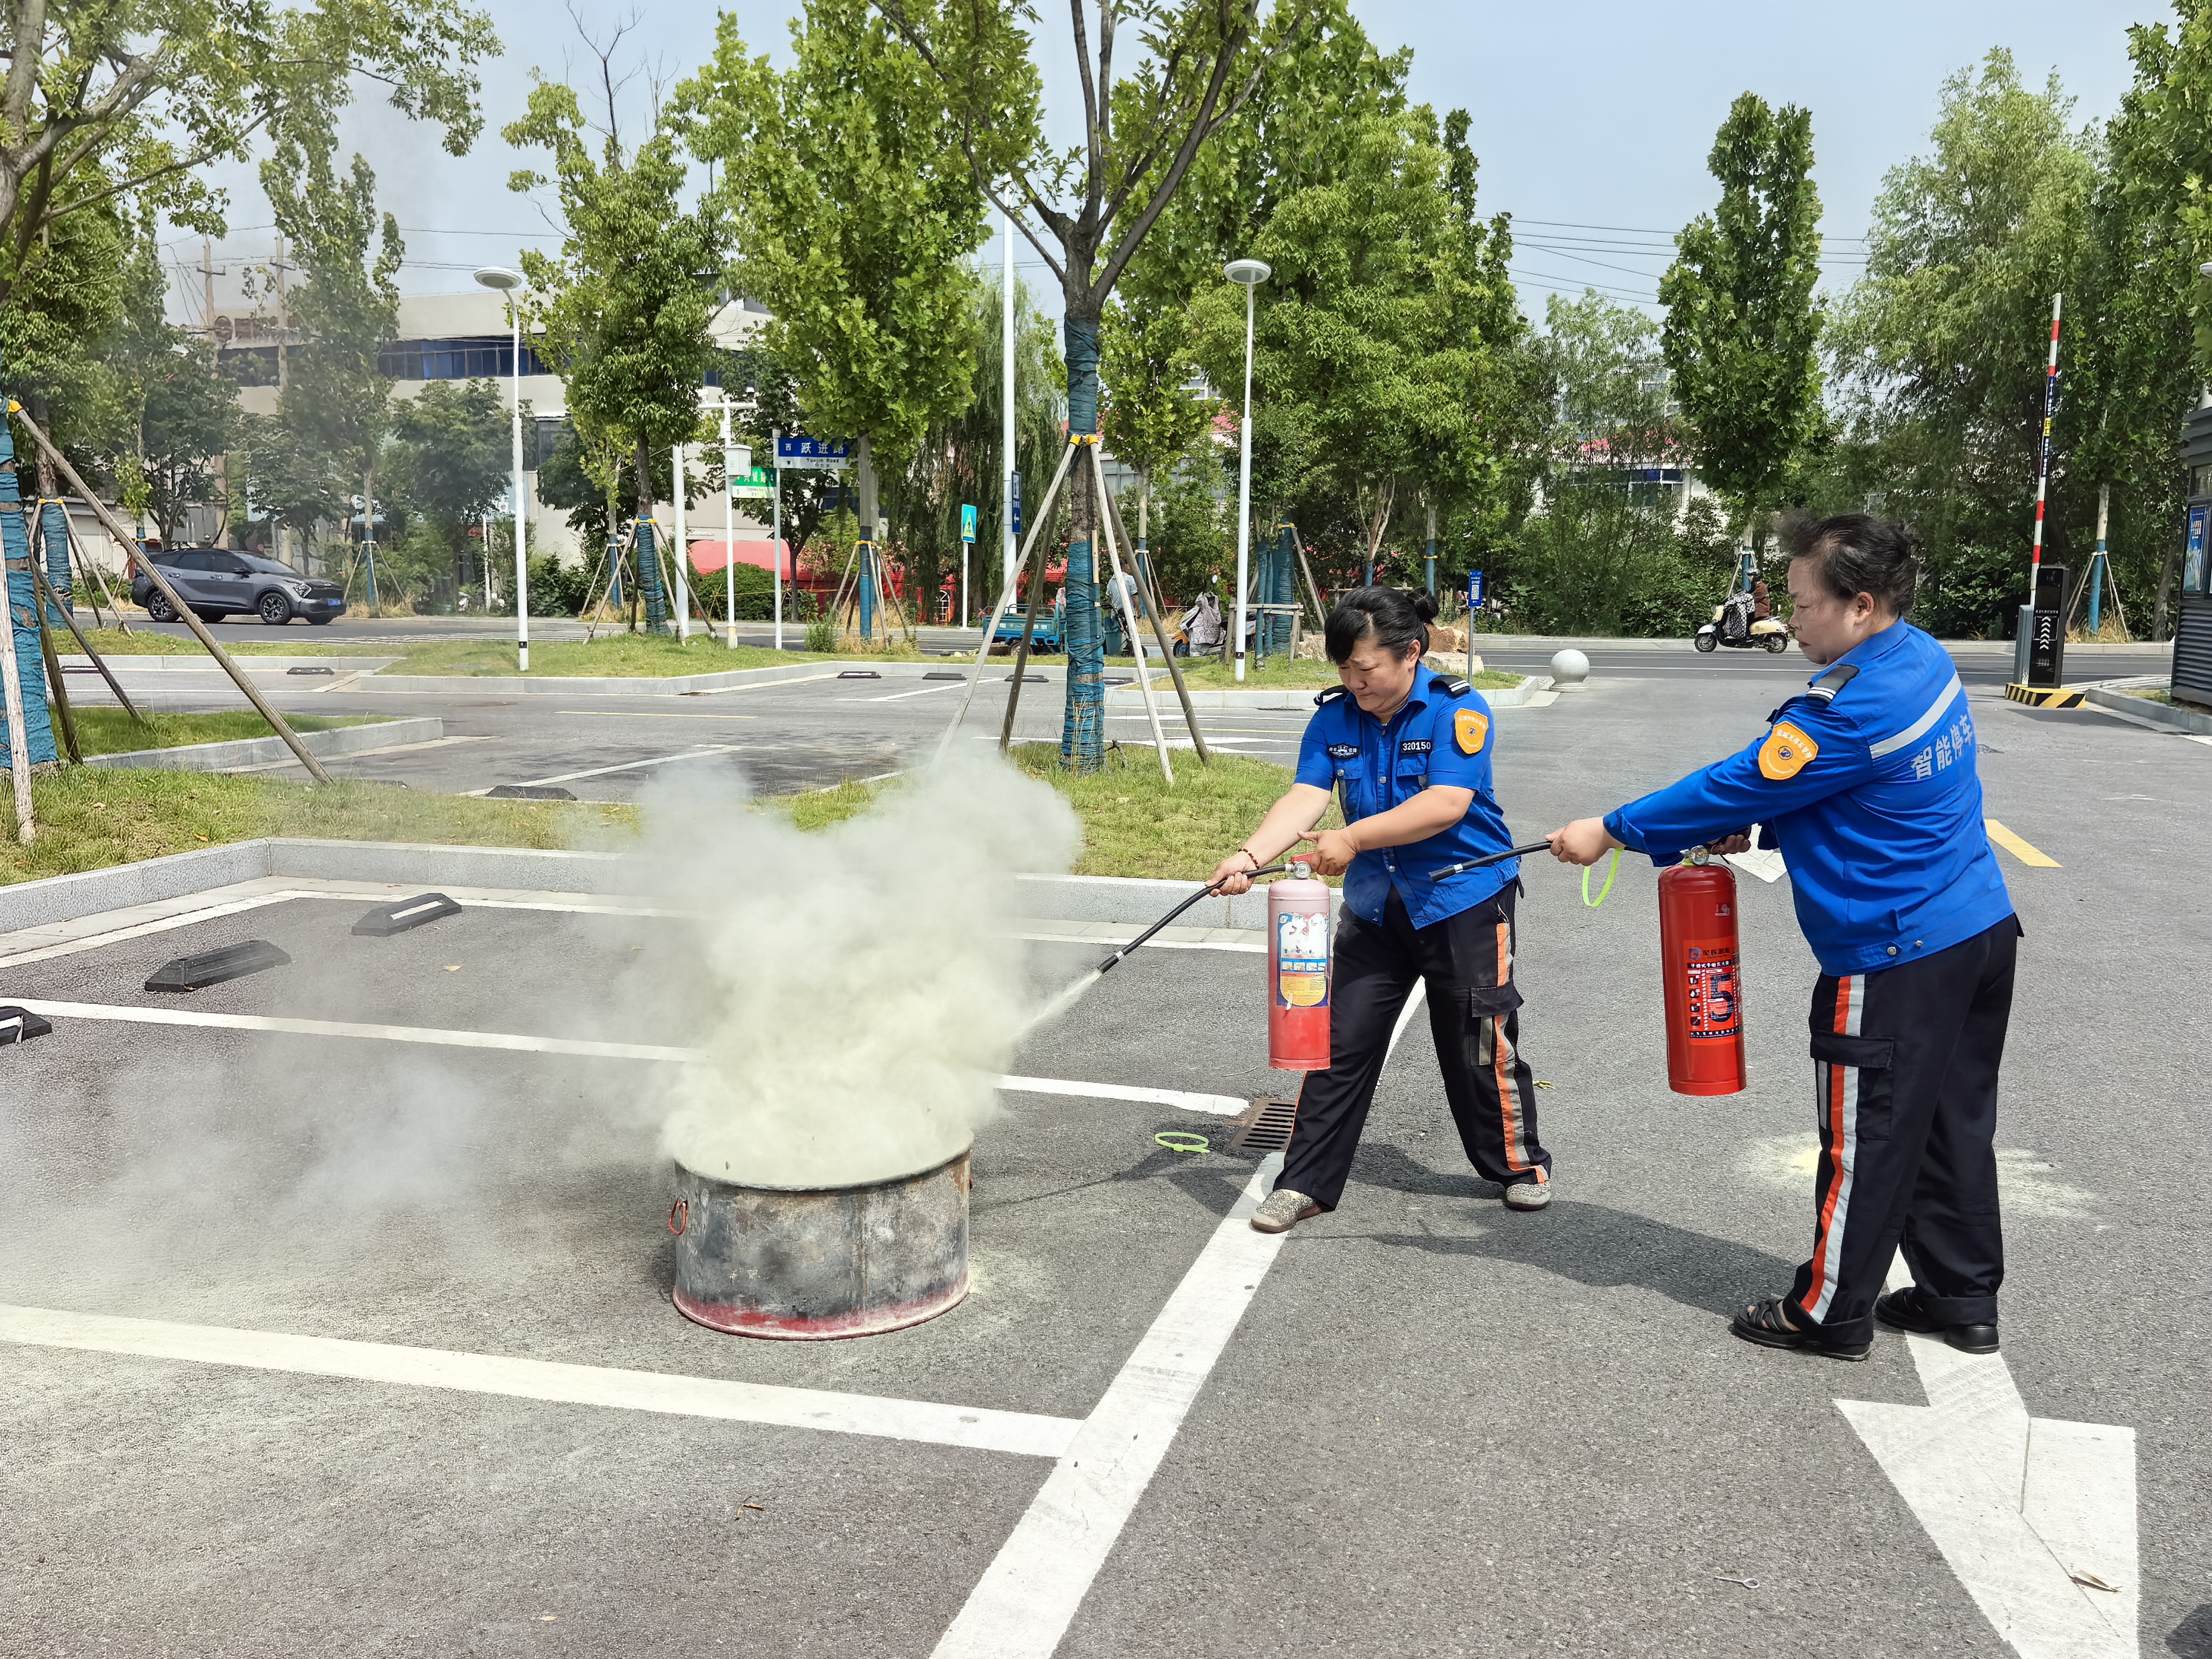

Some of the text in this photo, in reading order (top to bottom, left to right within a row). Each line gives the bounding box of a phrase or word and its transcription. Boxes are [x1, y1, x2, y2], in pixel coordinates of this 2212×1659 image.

[785, 443, 792, 451] 西
[1402, 741, 1431, 751] 320150
[1911, 707, 1974, 780] 智能停车
